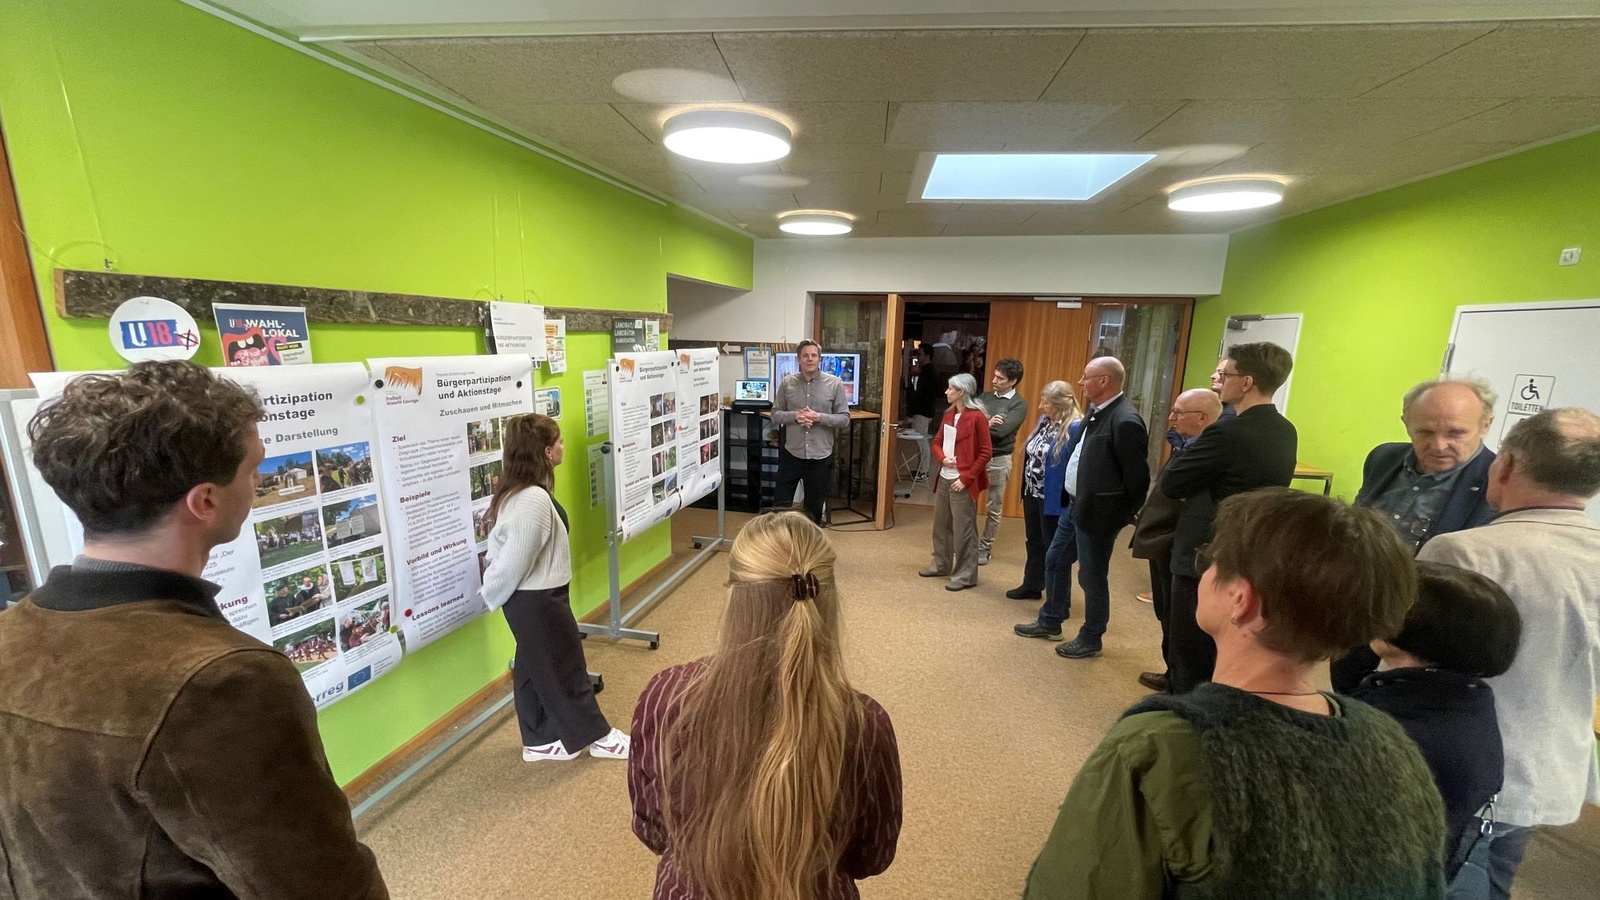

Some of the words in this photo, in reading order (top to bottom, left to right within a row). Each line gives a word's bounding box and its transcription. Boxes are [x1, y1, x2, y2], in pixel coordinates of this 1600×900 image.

[245, 318, 286, 328] WAHL-
[128, 321, 173, 347] U18
[262, 328, 300, 338] LOKAL
[437, 374, 512, 389] Bürgerpartizipation
[438, 390, 455, 400] und
[457, 386, 502, 399] Aktionstage
[440, 406, 478, 417] Zuschauen
[479, 402, 491, 411] und
[491, 398, 523, 409] Mitmachen
[1510, 402, 1545, 413] TOILETTEN
[275, 427, 339, 443] Darstellung
[392, 434, 406, 443] Ziel
[400, 490, 431, 503] Beispiele
[407, 551, 430, 566] Vorbild
[430, 546, 442, 556] und
[442, 538, 467, 551] Wirkung
[219, 596, 249, 610] kung
[412, 604, 440, 621] Lessons
[440, 592, 464, 608] learned
